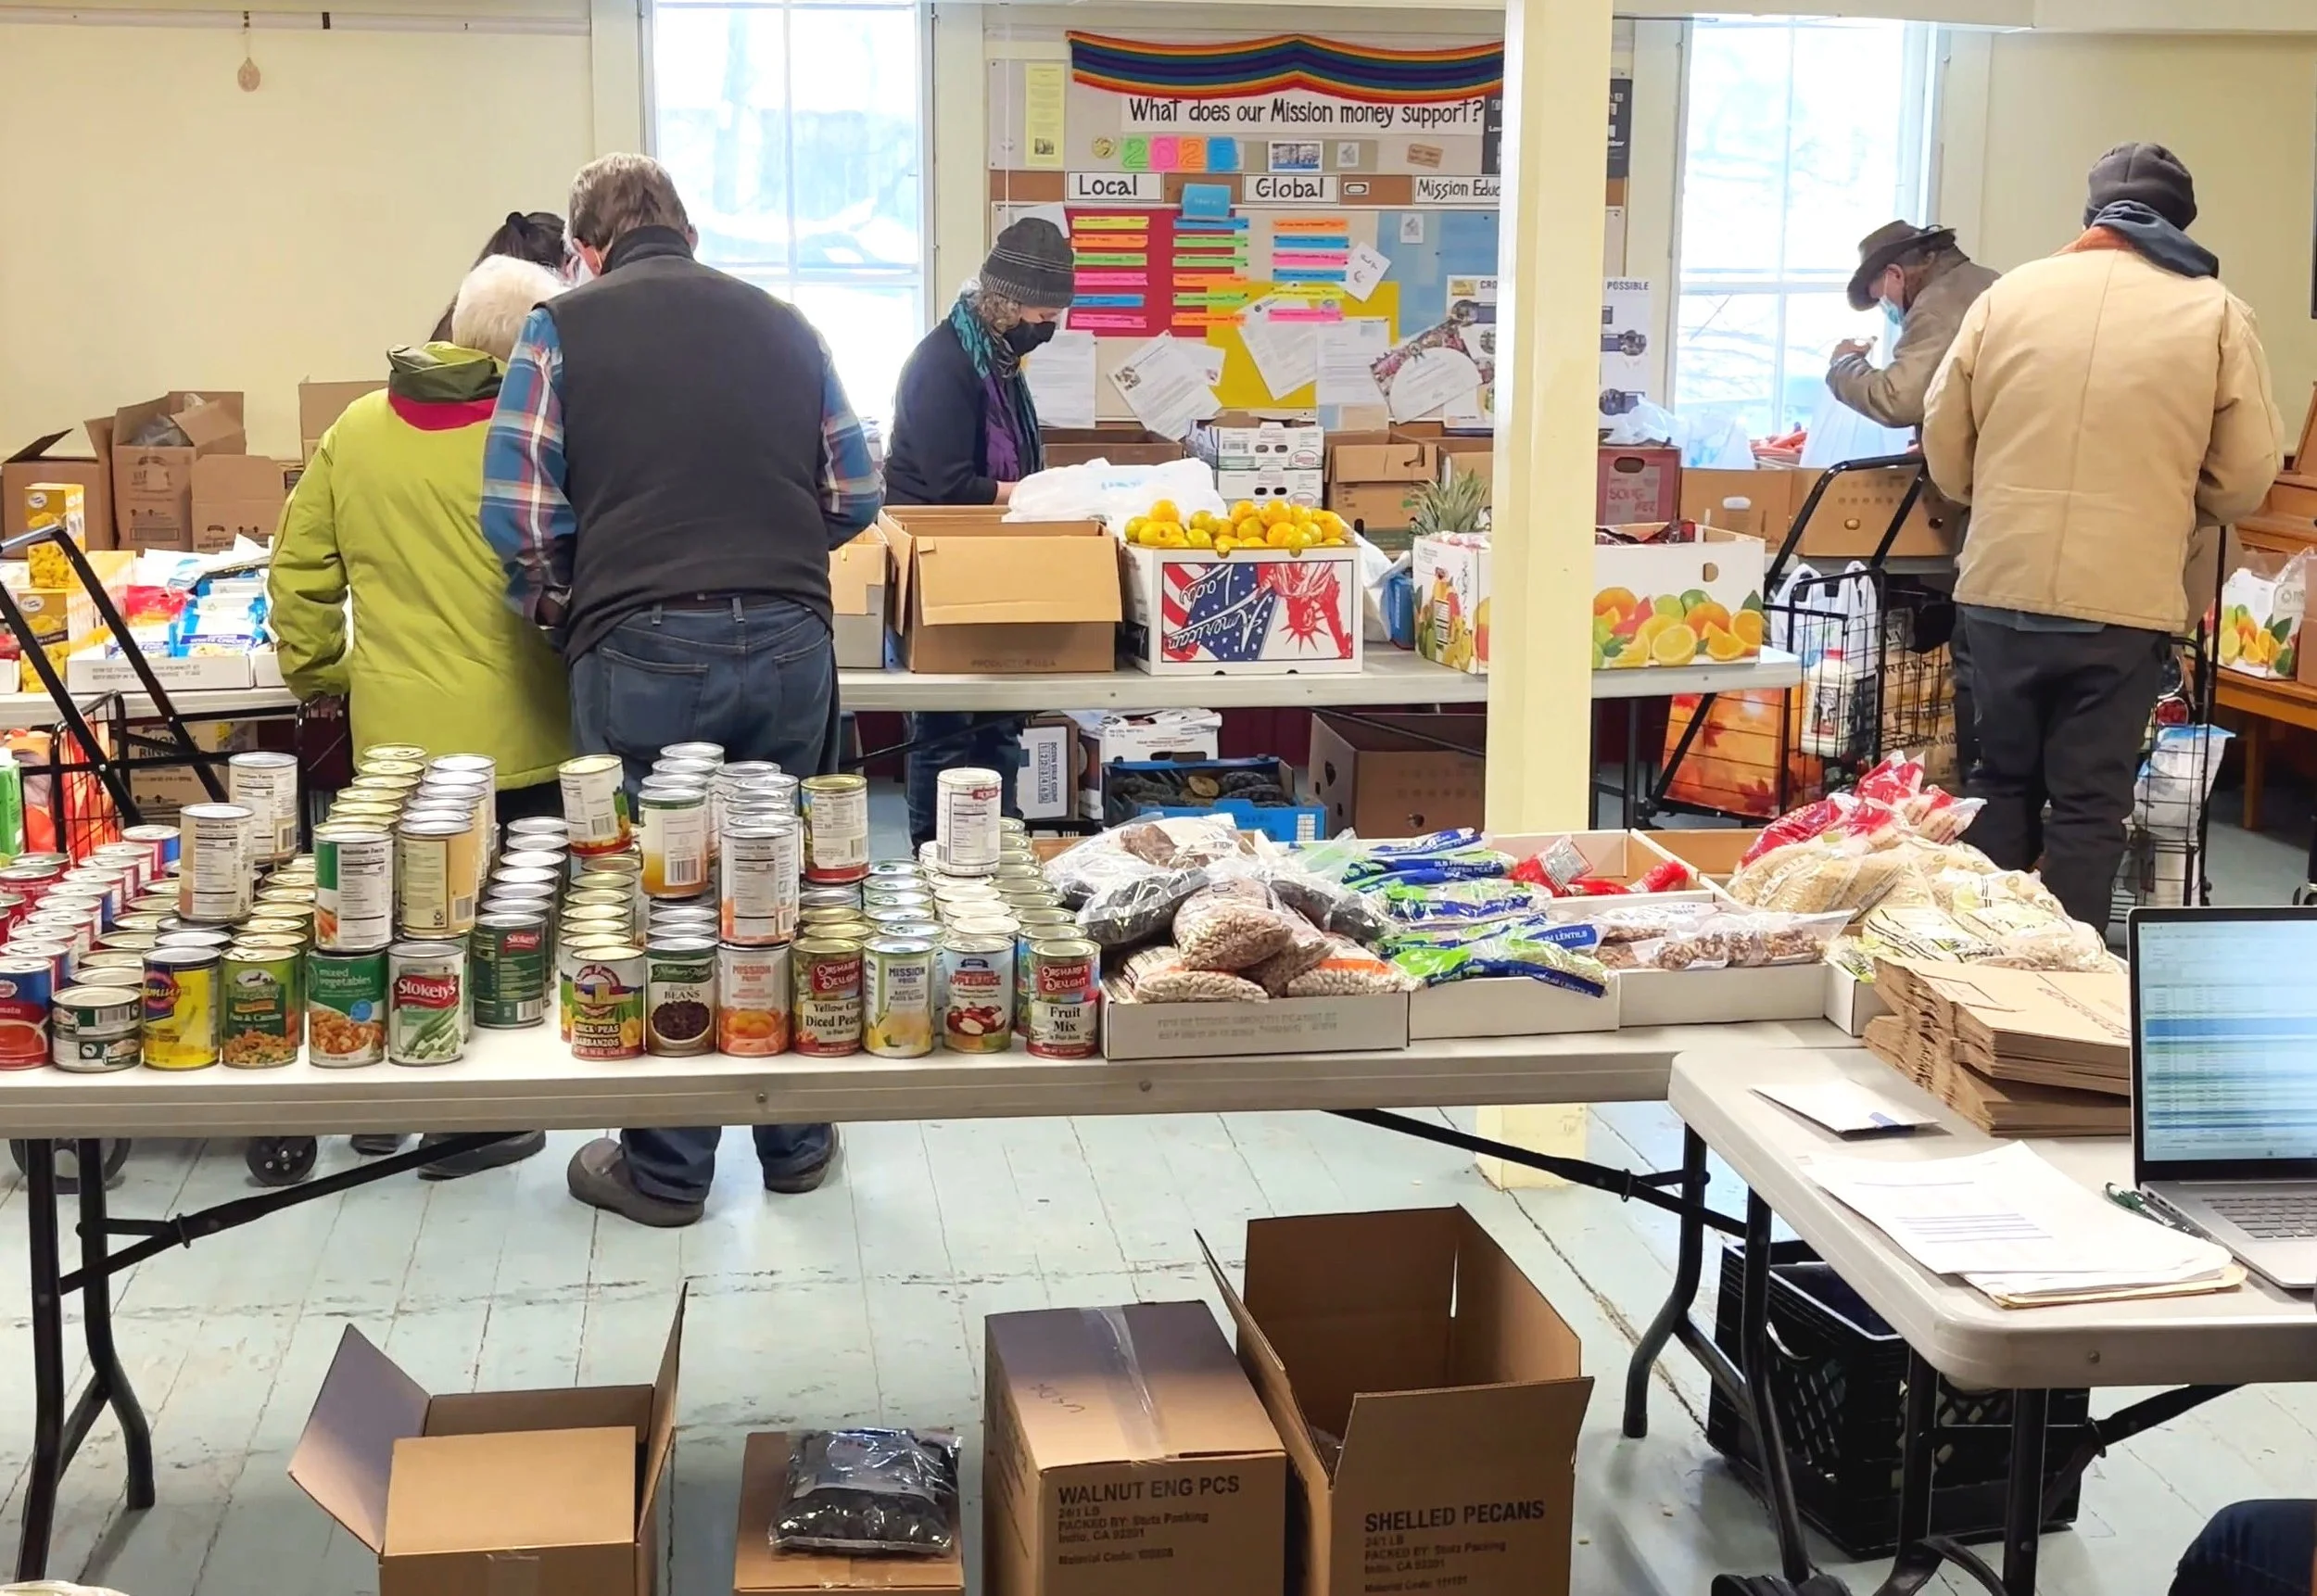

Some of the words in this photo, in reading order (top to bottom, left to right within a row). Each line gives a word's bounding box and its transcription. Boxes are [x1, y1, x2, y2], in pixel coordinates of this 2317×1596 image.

[1130, 97, 1182, 122] What
[1189, 100, 1230, 121] does
[1237, 106, 1266, 122] our
[1271, 97, 1333, 122] Mission
[1340, 105, 1394, 128] money
[1401, 99, 1483, 129] support?
[1079, 174, 1137, 196] Local
[1256, 177, 1323, 198] Global
[1416, 179, 1468, 200] Mission
[1606, 281, 1649, 291] POSSIBLE
[1168, 593, 1271, 652] American
[1555, 930, 1588, 942] LENTILS
[889, 967, 925, 977] MISSION
[397, 976, 457, 1000] Stokely's
[664, 989, 701, 1000] BEANS
[814, 1002, 844, 1013] Yellow
[1050, 1006, 1082, 1020] Fruit
[805, 1015, 835, 1027] Diced
[1053, 1020, 1077, 1032] Mix
[1058, 1481, 1146, 1505] WALNUT
[1151, 1478, 1194, 1498] ENG
[1199, 1476, 1240, 1495] PCS
[1058, 1519, 1108, 1531] PACKED
[1164, 1512, 1209, 1526] Packing
[1364, 1507, 1457, 1533] SHELLED
[1463, 1500, 1545, 1524] PECANS
[1093, 1529, 1110, 1541] CA
[1389, 1535, 1404, 1546] LB
[1364, 1547, 1411, 1561] PACKED
[1464, 1540, 1507, 1553] Packing
[1396, 1561, 1412, 1573] CA
